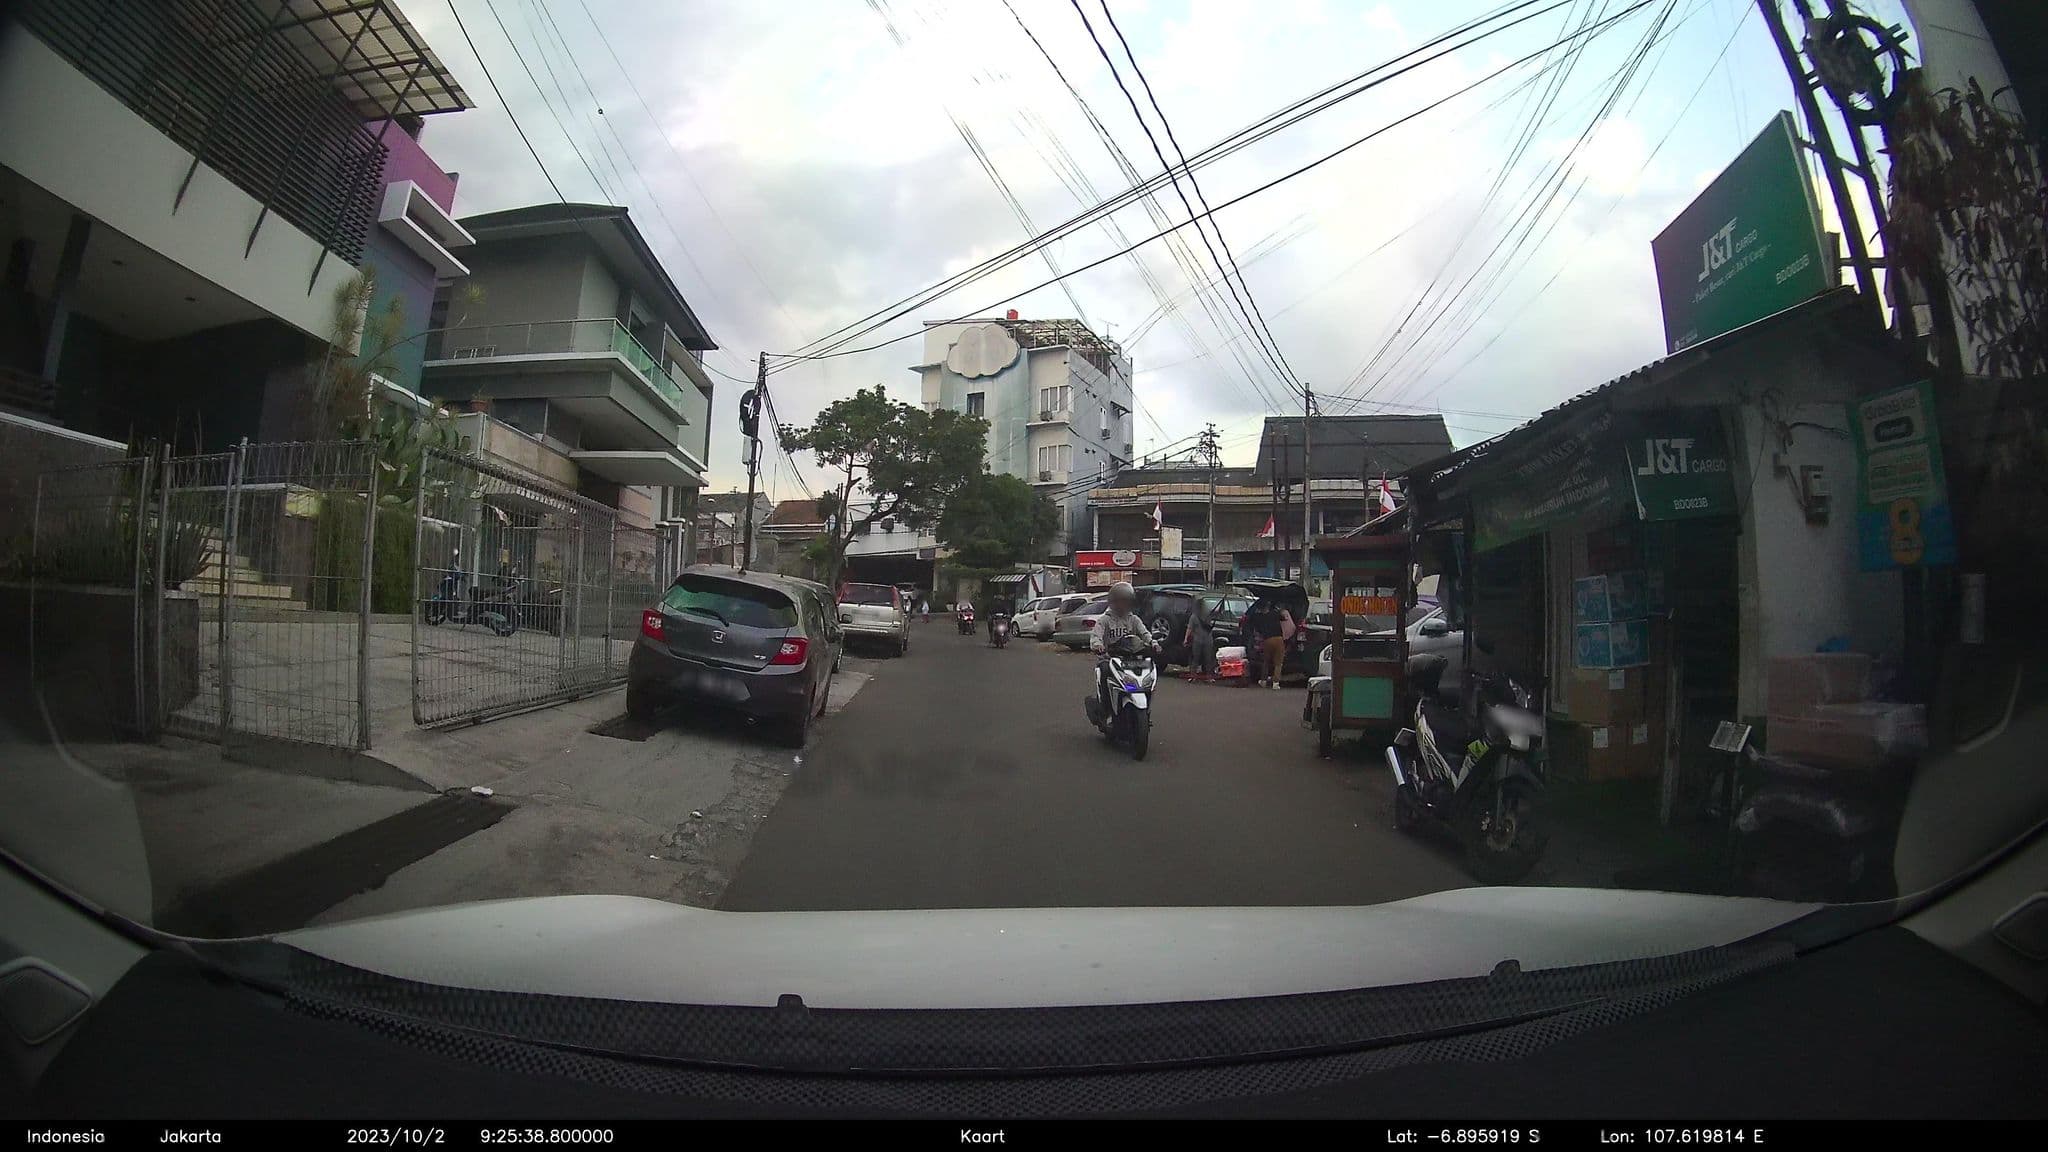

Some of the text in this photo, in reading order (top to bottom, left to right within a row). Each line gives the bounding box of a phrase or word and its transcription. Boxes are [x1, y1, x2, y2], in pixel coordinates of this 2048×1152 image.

[1698, 217, 1758, 282] J&T CARGO
[1637, 438, 1727, 476] J&T CARGO
